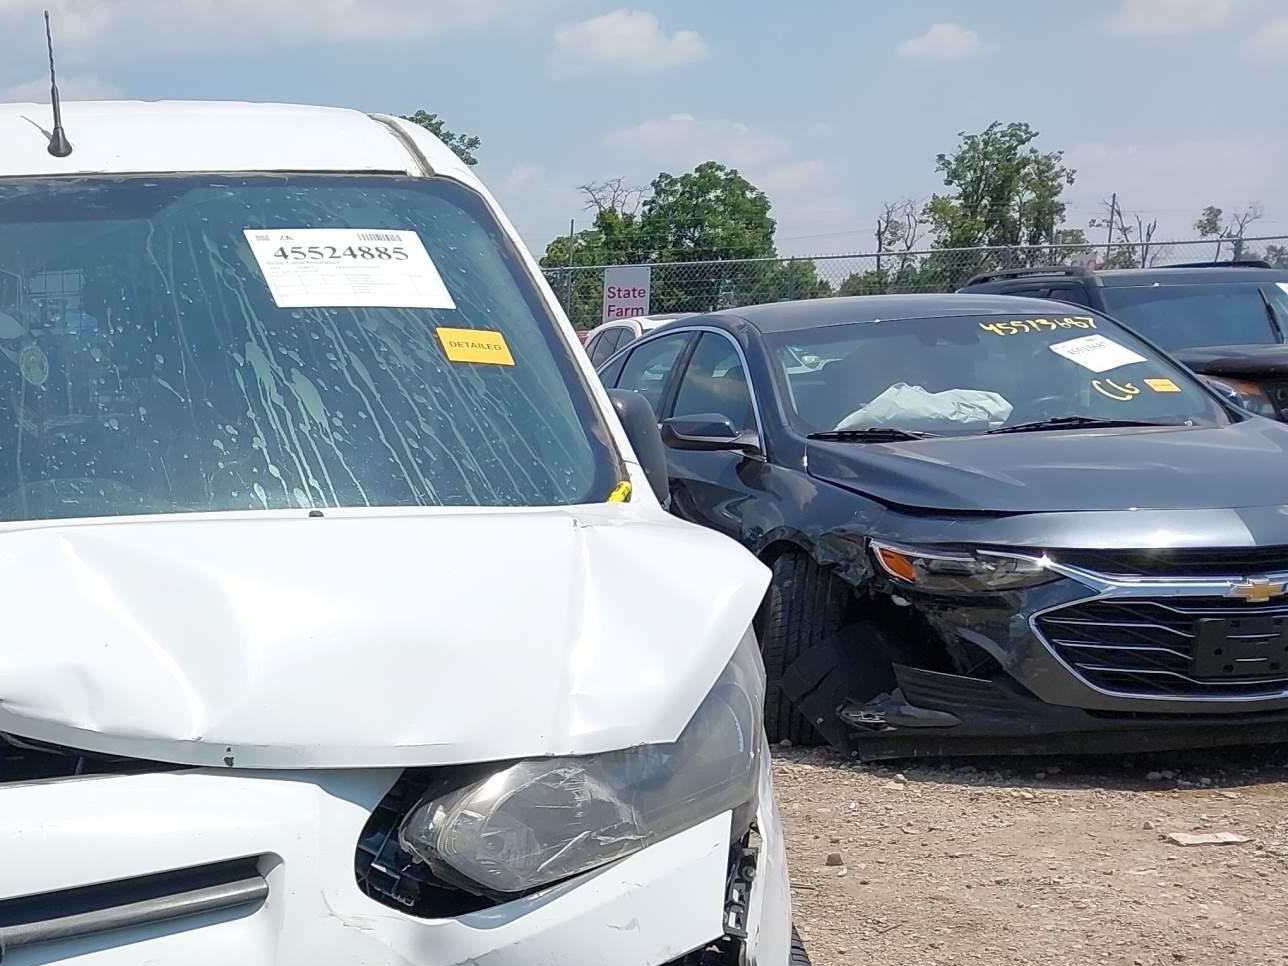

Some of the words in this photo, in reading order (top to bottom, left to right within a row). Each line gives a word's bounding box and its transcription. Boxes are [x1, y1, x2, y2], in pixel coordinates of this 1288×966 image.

[273, 244, 409, 261] 45524885
[607, 286, 646, 299] State
[607, 304, 645, 318] Farm
[449, 340, 502, 352] DETAILED
